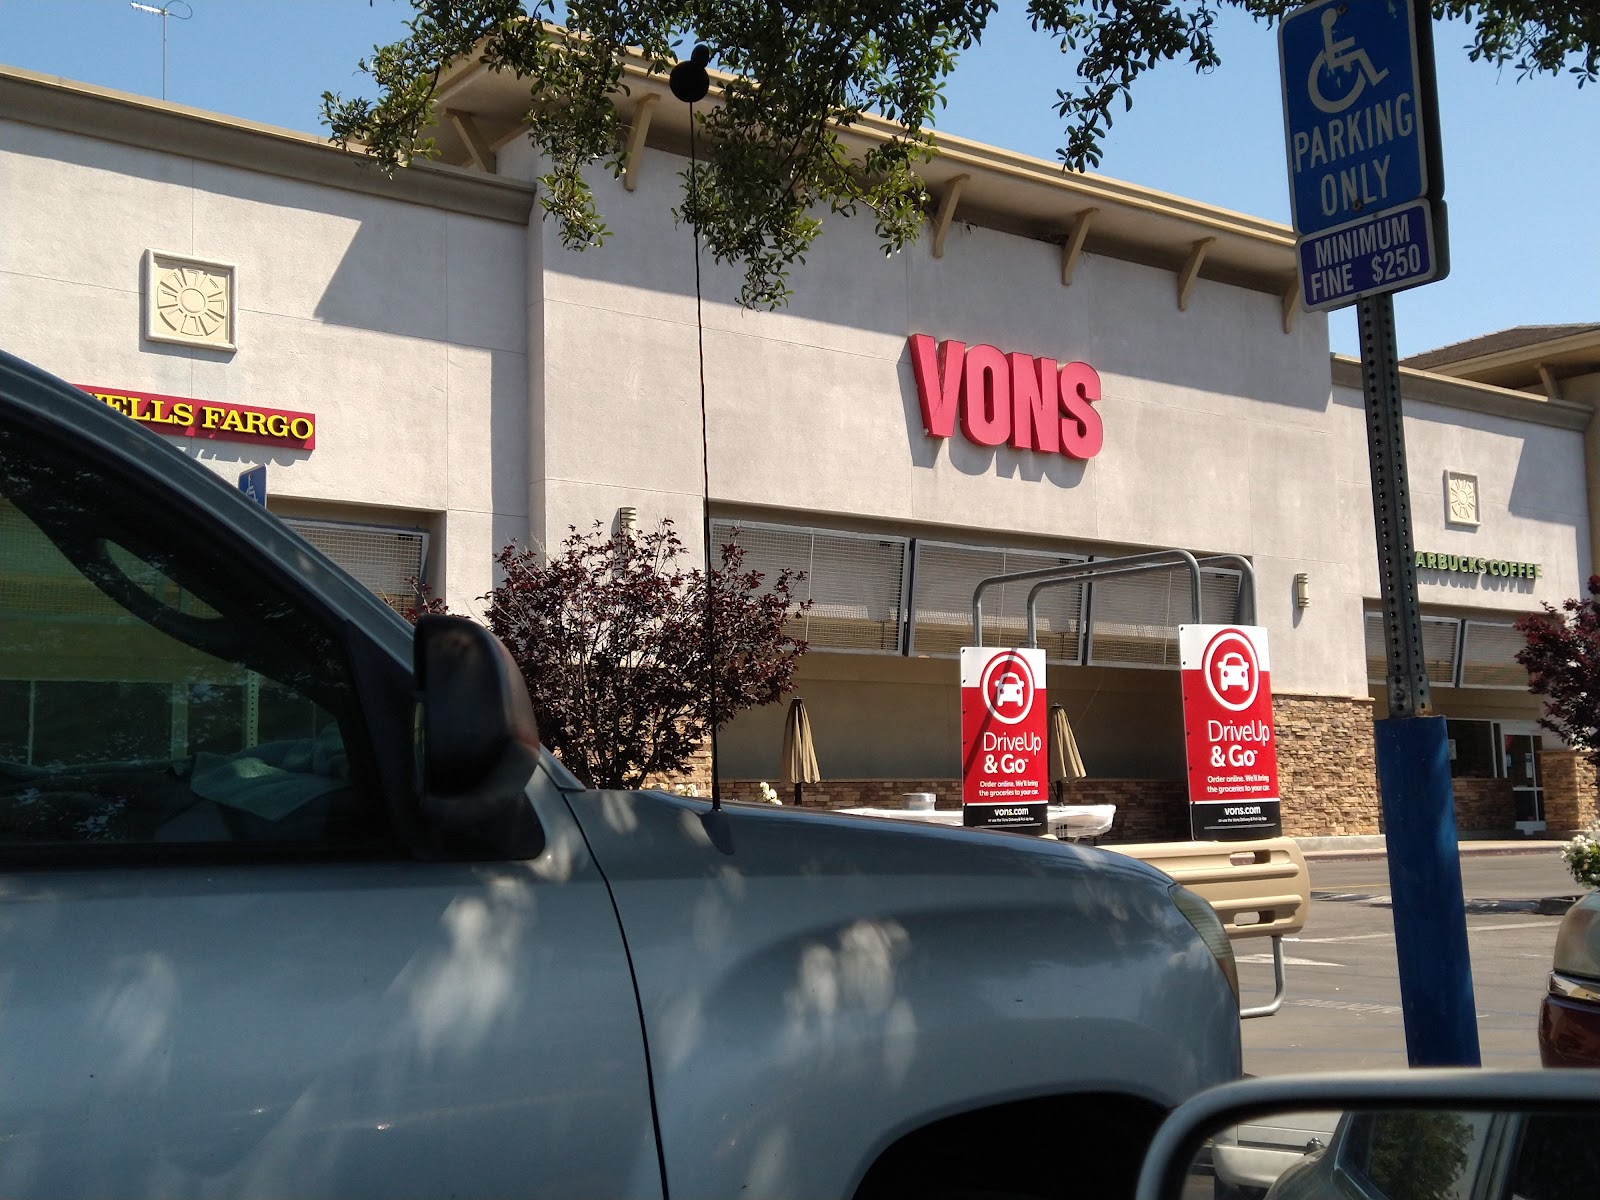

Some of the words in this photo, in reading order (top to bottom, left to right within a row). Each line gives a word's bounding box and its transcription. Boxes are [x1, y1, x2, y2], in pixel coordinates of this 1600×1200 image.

[1293, 92, 1413, 173] PARKING
[1320, 155, 1391, 216] ONLY
[1315, 214, 1411, 269] MINIMUM
[1311, 263, 1354, 301] FINE
[1371, 244, 1421, 285] $250
[908, 333, 1103, 459] VONS
[202, 406, 314, 440] FARGO
[1415, 551, 1487, 574] ARBUCKS
[1488, 559, 1543, 579] COFFEE
[984, 732, 1042, 756] DriveUp
[1208, 720, 1270, 746] DriveUp
[984, 754, 998, 774] &
[1211, 745, 1226, 768] &
[1027, 780, 1038, 788] bring
[1218, 786, 1245, 794] groceries
[1258, 774, 1269, 783] bring
[989, 790, 1014, 798] groceries
[994, 807, 1029, 817] vons.com
[1224, 806, 1261, 816] vons.com
